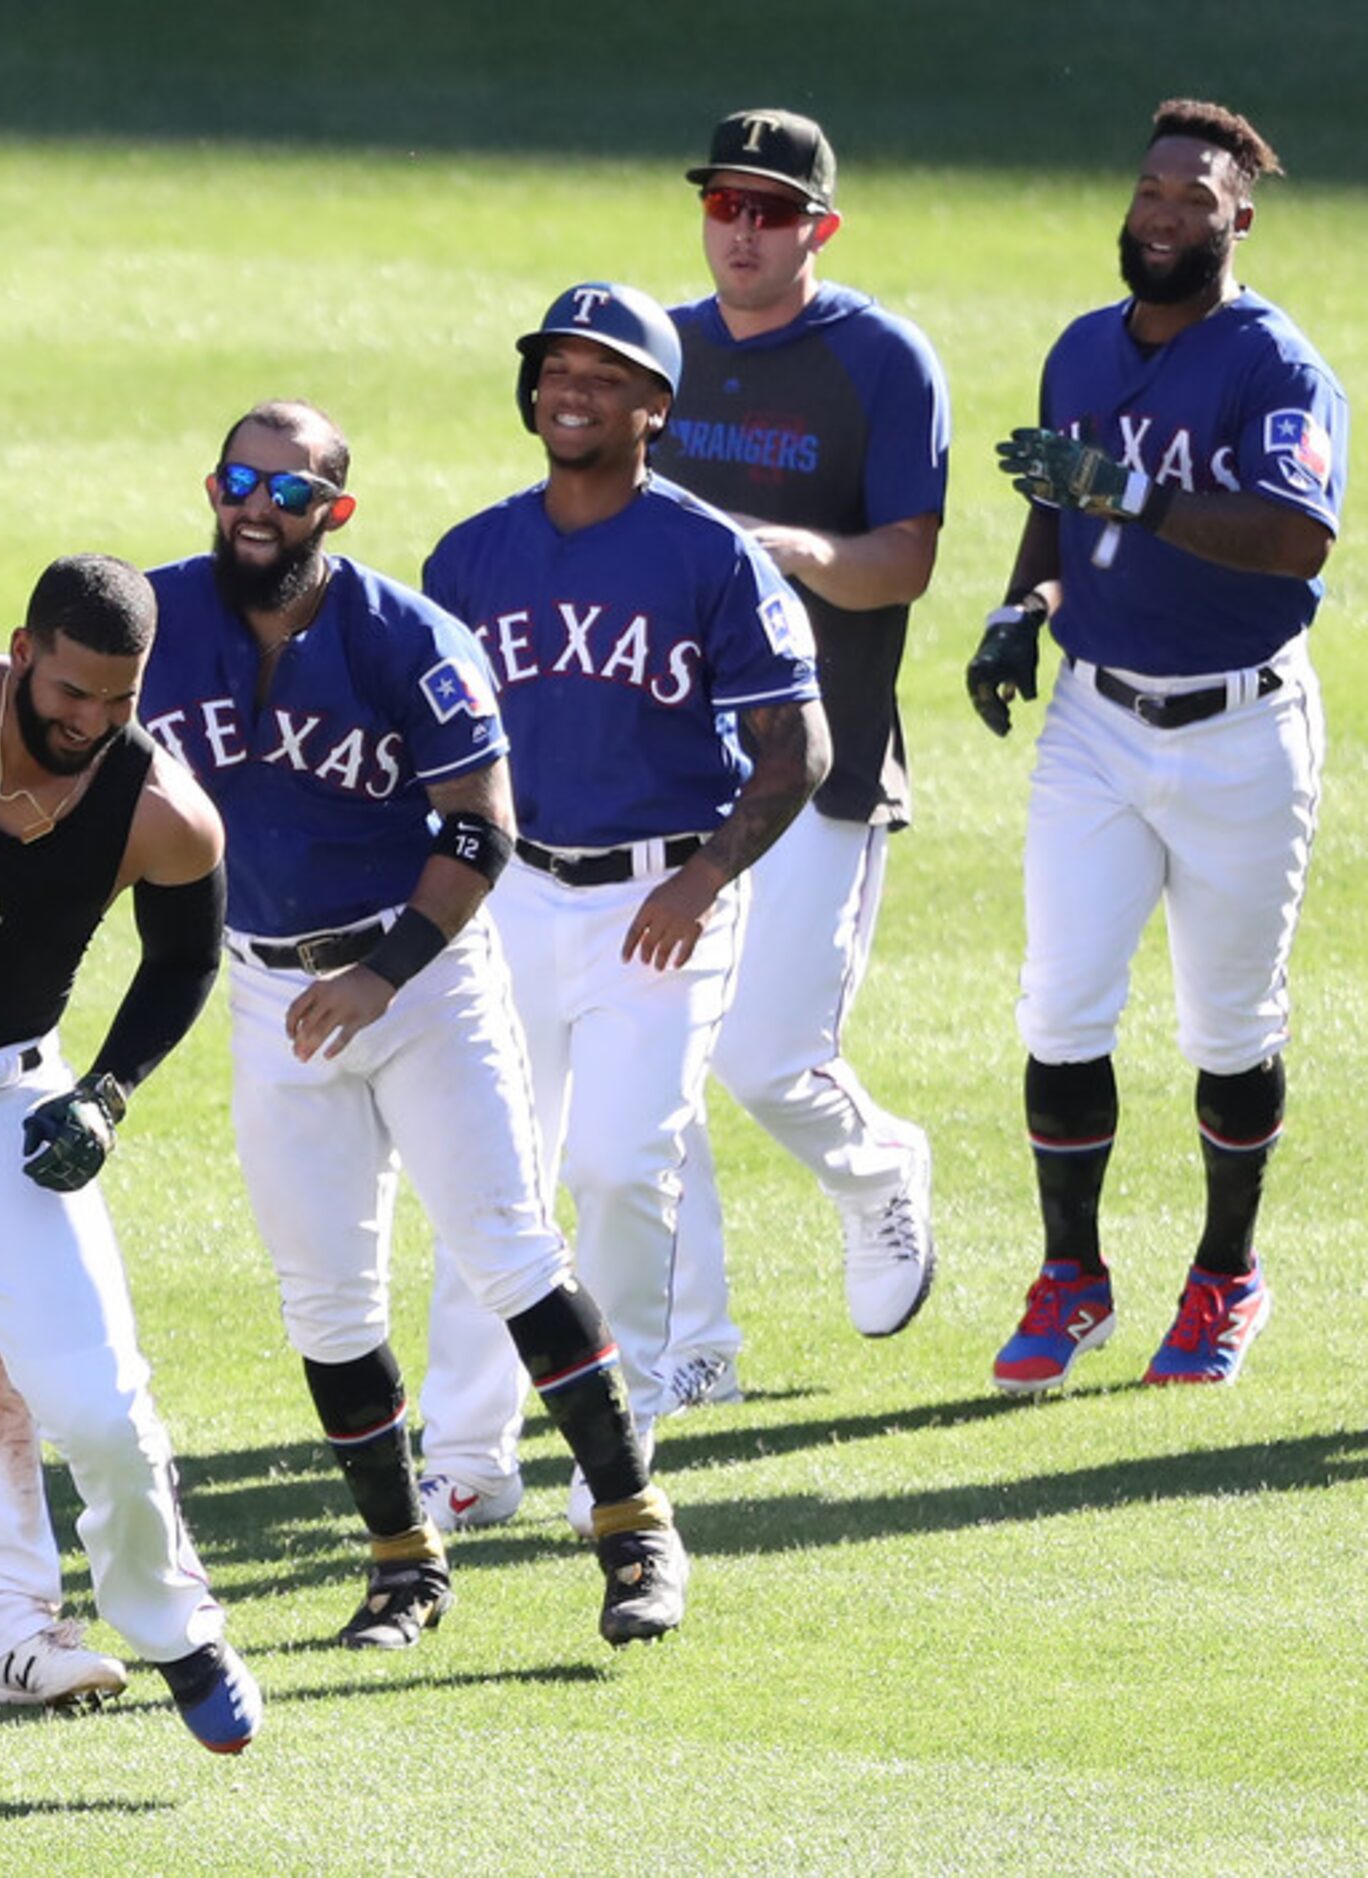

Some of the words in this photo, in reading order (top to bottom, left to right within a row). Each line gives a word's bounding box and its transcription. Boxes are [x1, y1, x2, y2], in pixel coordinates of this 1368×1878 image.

[742, 115, 781, 152] T
[573, 289, 610, 324] T
[689, 419, 820, 474] RANGERS
[146, 698, 403, 798] TEXAS
[455, 834, 479, 860] 12
